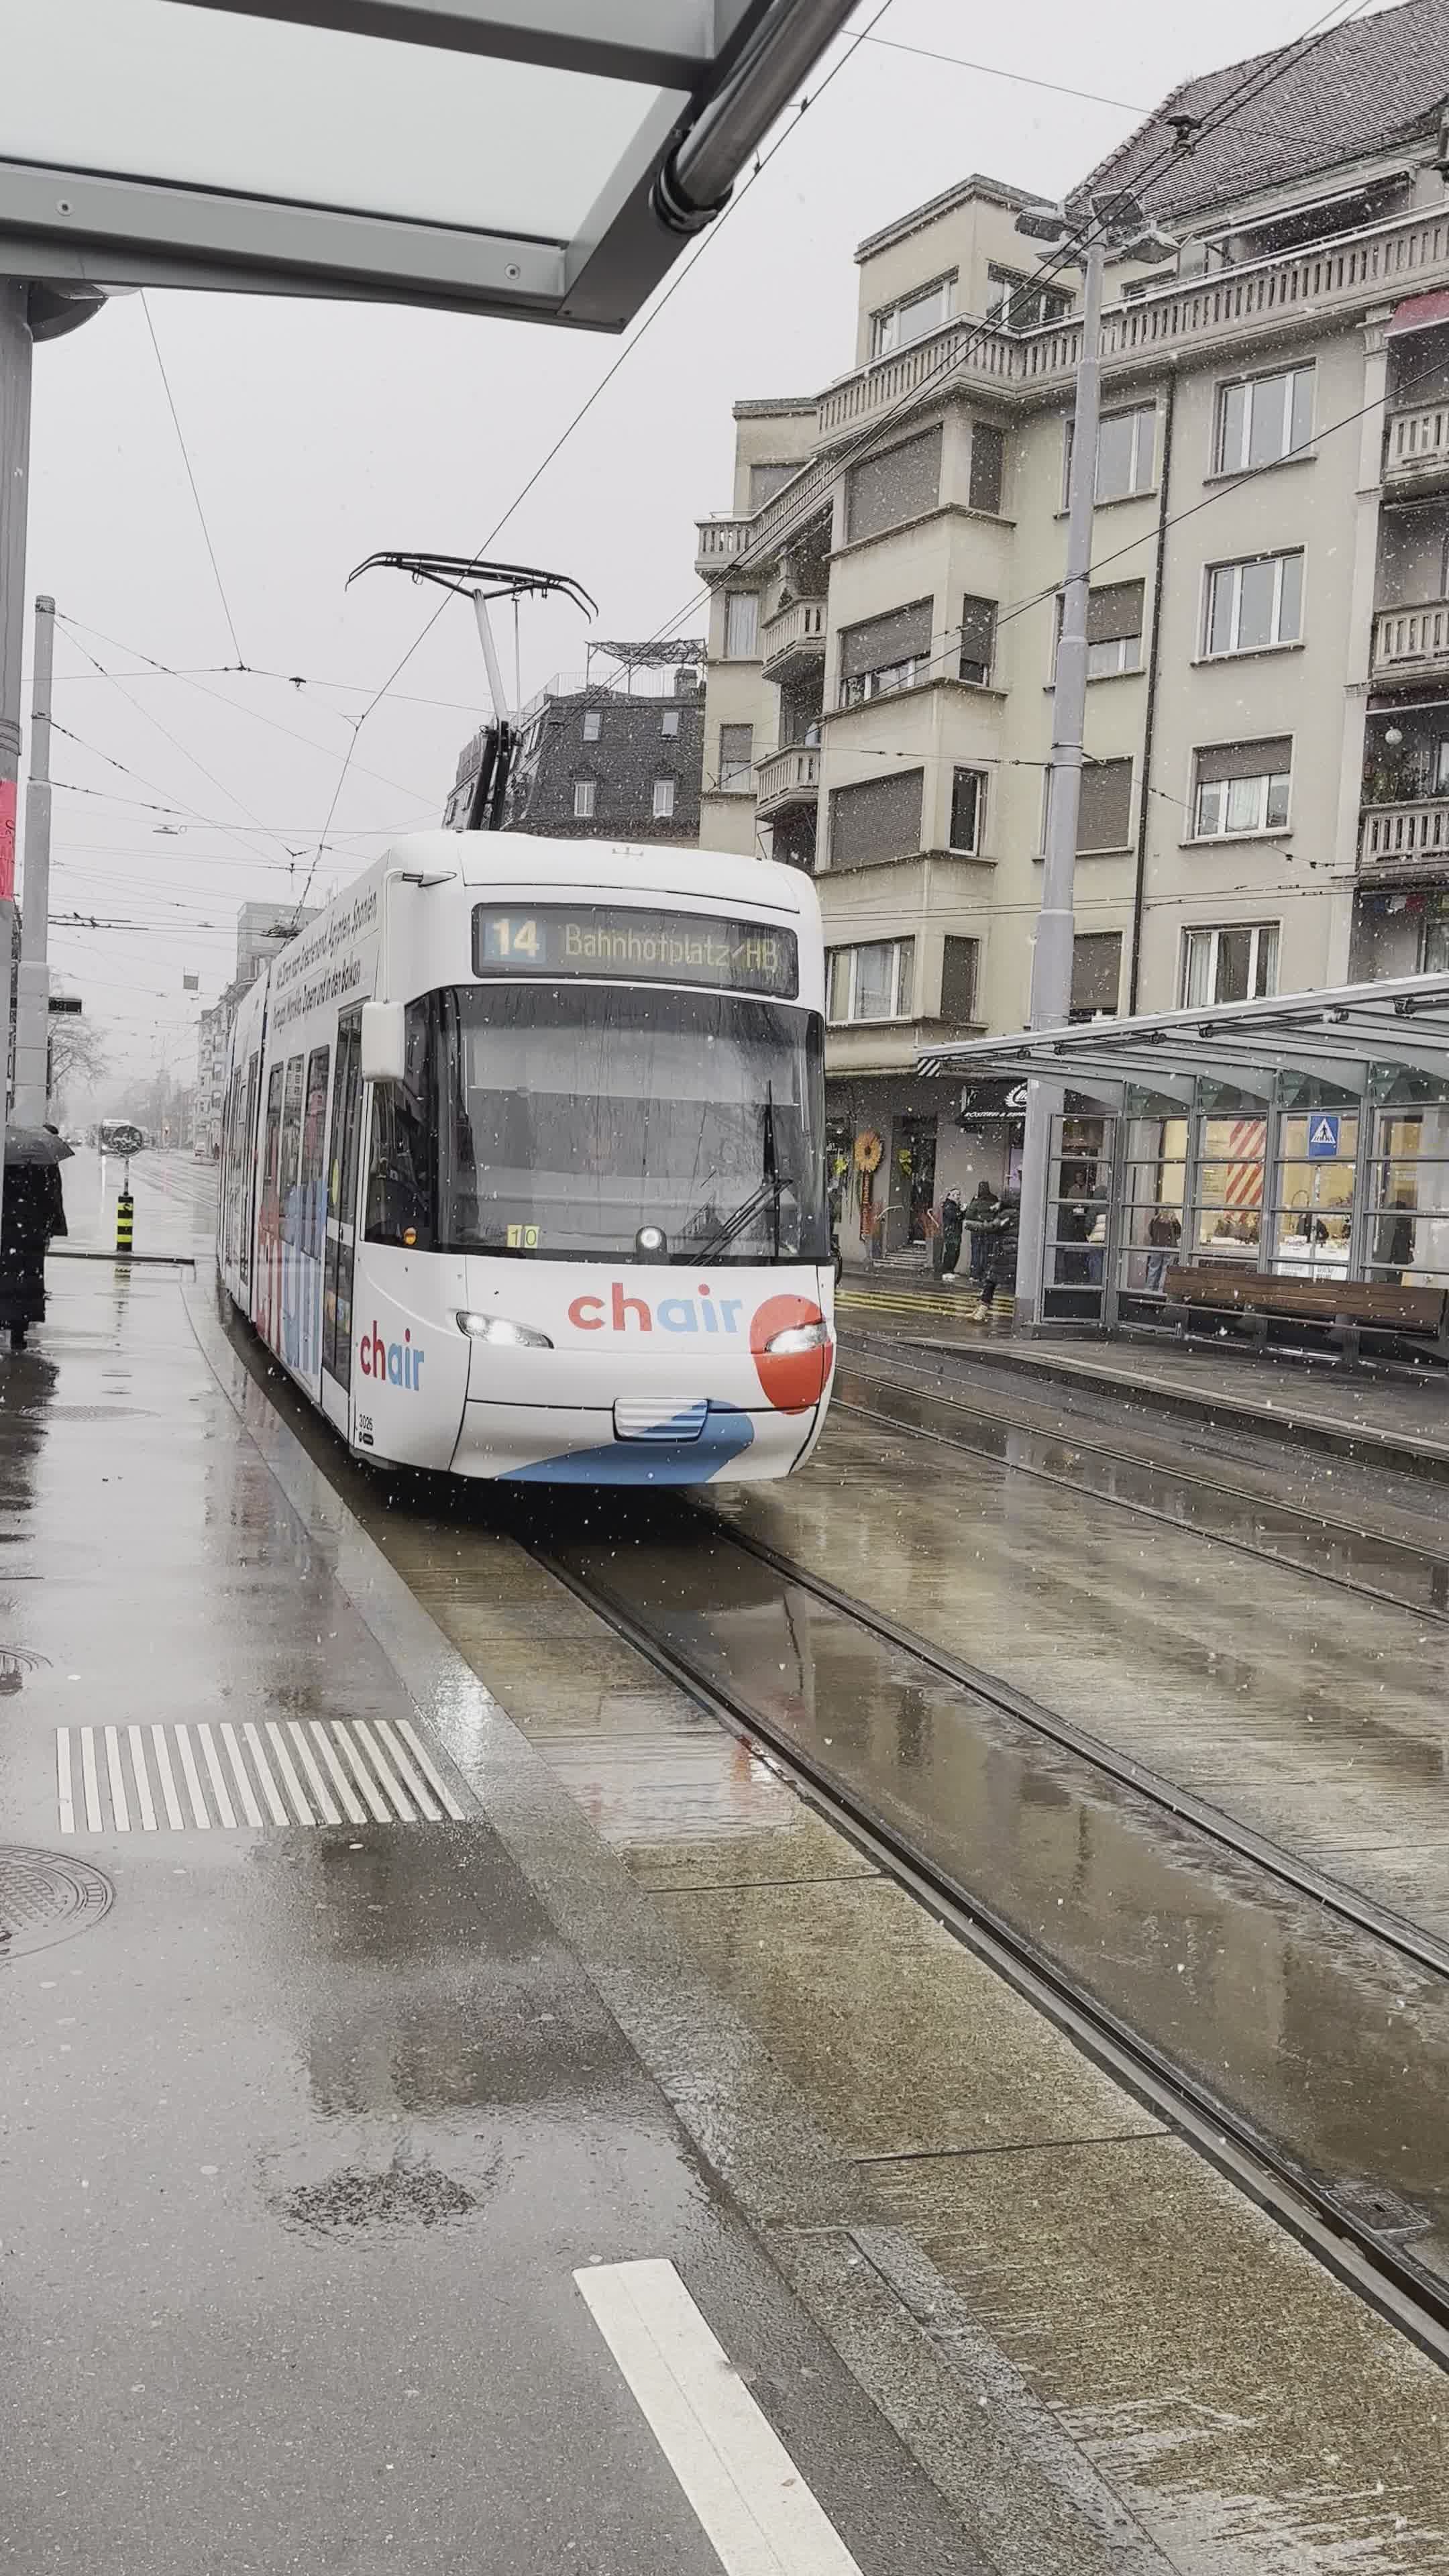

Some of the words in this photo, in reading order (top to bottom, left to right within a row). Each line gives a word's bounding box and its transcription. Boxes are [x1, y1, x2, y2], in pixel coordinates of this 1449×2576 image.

[493, 918, 539, 957] 14
[511, 1228, 537, 1246] 10
[568, 1281, 743, 1334] chair
[360, 1320, 425, 1391] chair
